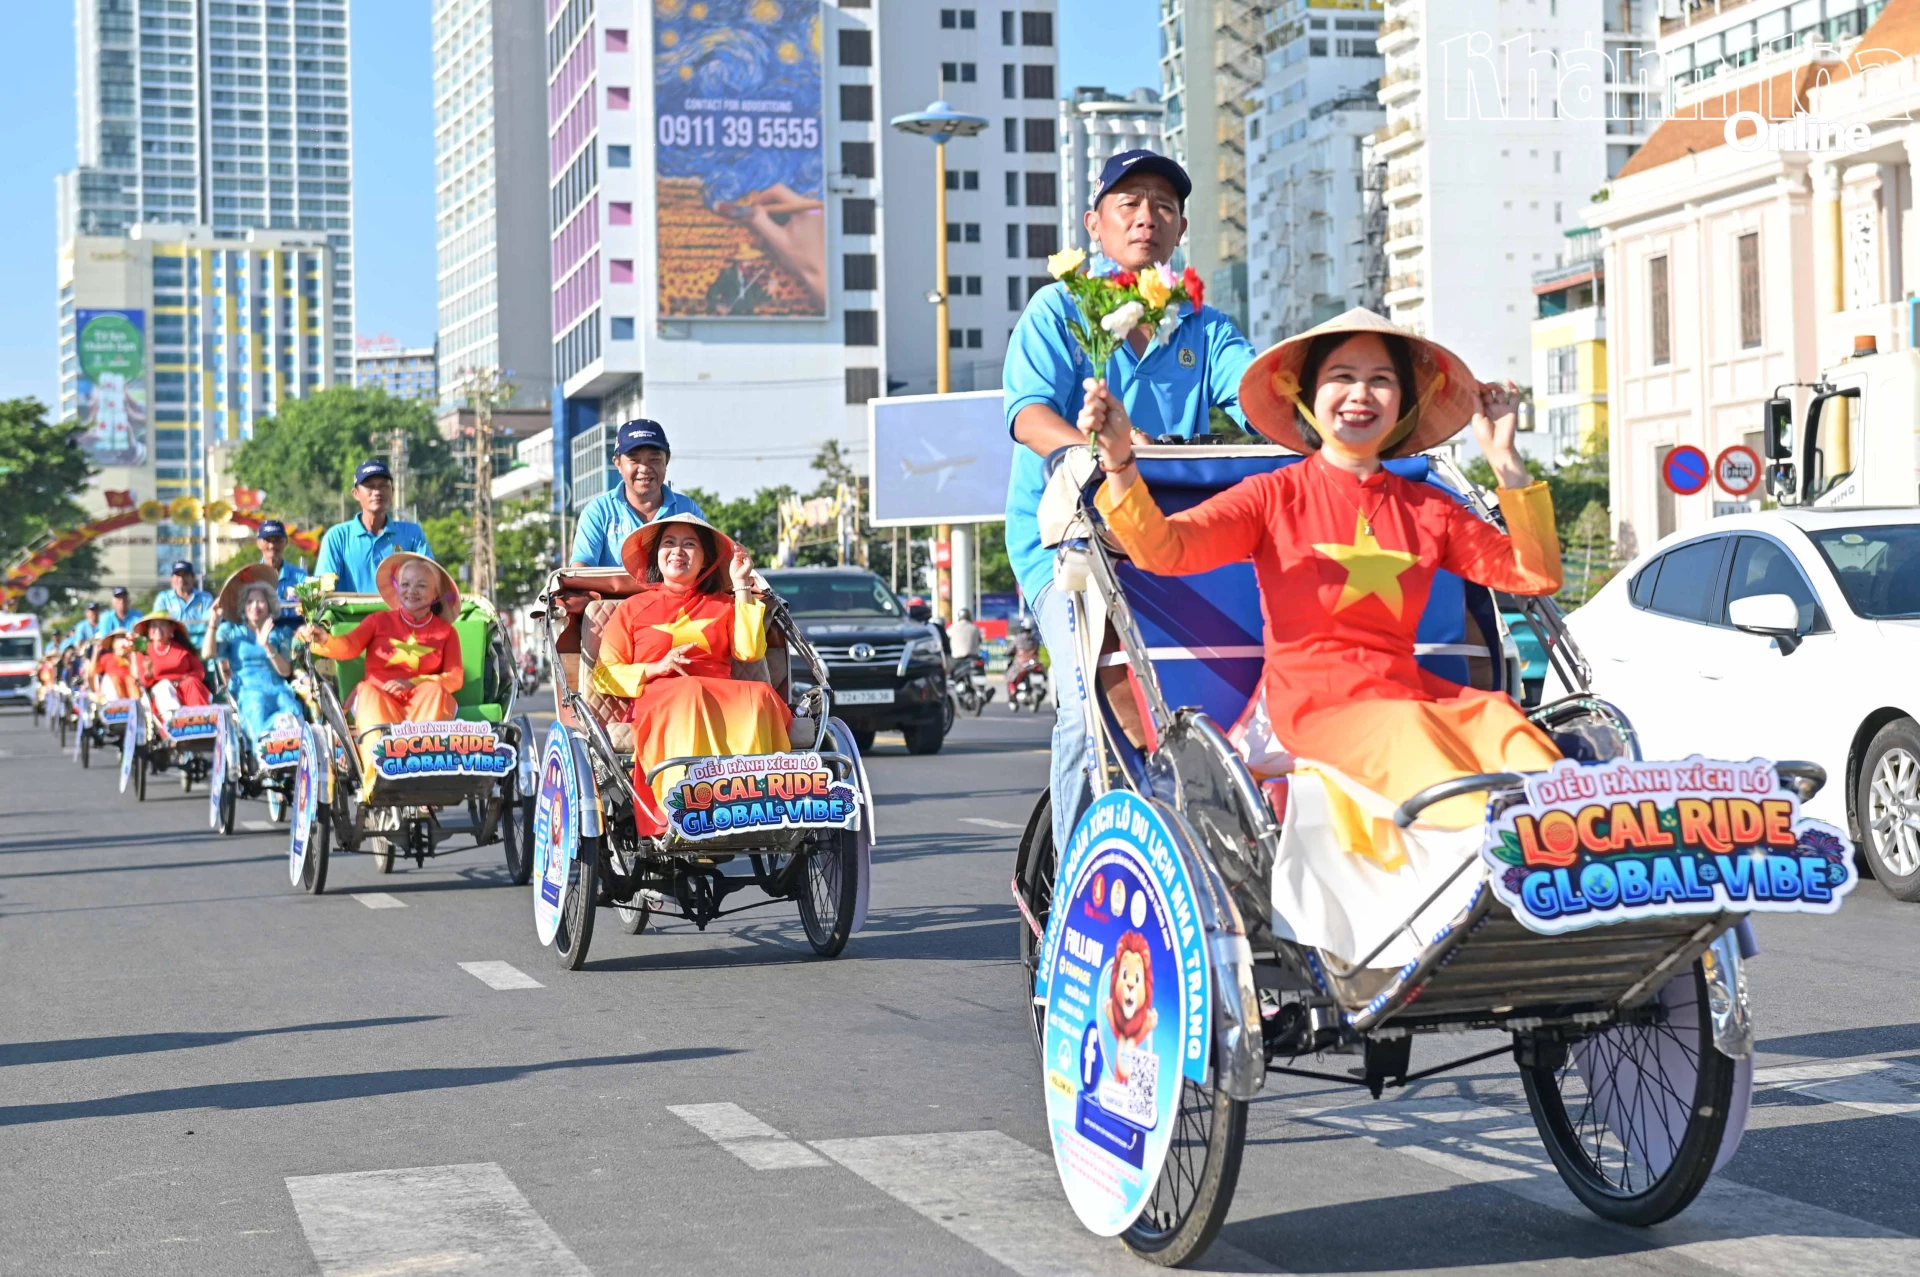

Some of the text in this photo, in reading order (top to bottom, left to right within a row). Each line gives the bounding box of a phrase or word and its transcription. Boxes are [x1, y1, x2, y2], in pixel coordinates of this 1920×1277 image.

[684, 98, 793, 113] CONTACT FOR ADVERTISING
[659, 114, 819, 149] 0911 39 5555
[1830, 484, 1856, 507] HINO
[449, 721, 474, 733] XÍCH
[384, 734, 496, 758] LOCAL RIDE
[382, 753, 506, 775] GLOBAL VIBE
[728, 758, 765, 775] HÀNH
[768, 756, 798, 771] XÍCH
[801, 758, 819, 771] LÔ
[1603, 764, 1669, 795] HÀNH
[1677, 762, 1732, 794] XÍCH
[1740, 763, 1773, 794] LÔ
[682, 772, 829, 810] LOCAL RIDE
[682, 799, 846, 835] GLOBAL VIBE
[1514, 798, 1795, 866] LOCAL RIDE
[1521, 853, 1832, 918] GLOBAL VIBE
[1089, 803, 1115, 841] XÍCH
[1116, 799, 1131, 831] LÔ
[1131, 810, 1149, 844] DU
[1147, 829, 1176, 888] LỊCH
[1170, 881, 1195, 948] NHA
[1186, 949, 1203, 1060] TRANG
[1064, 926, 1104, 969] FOLLOW
[1066, 960, 1092, 987] FANPAGE
